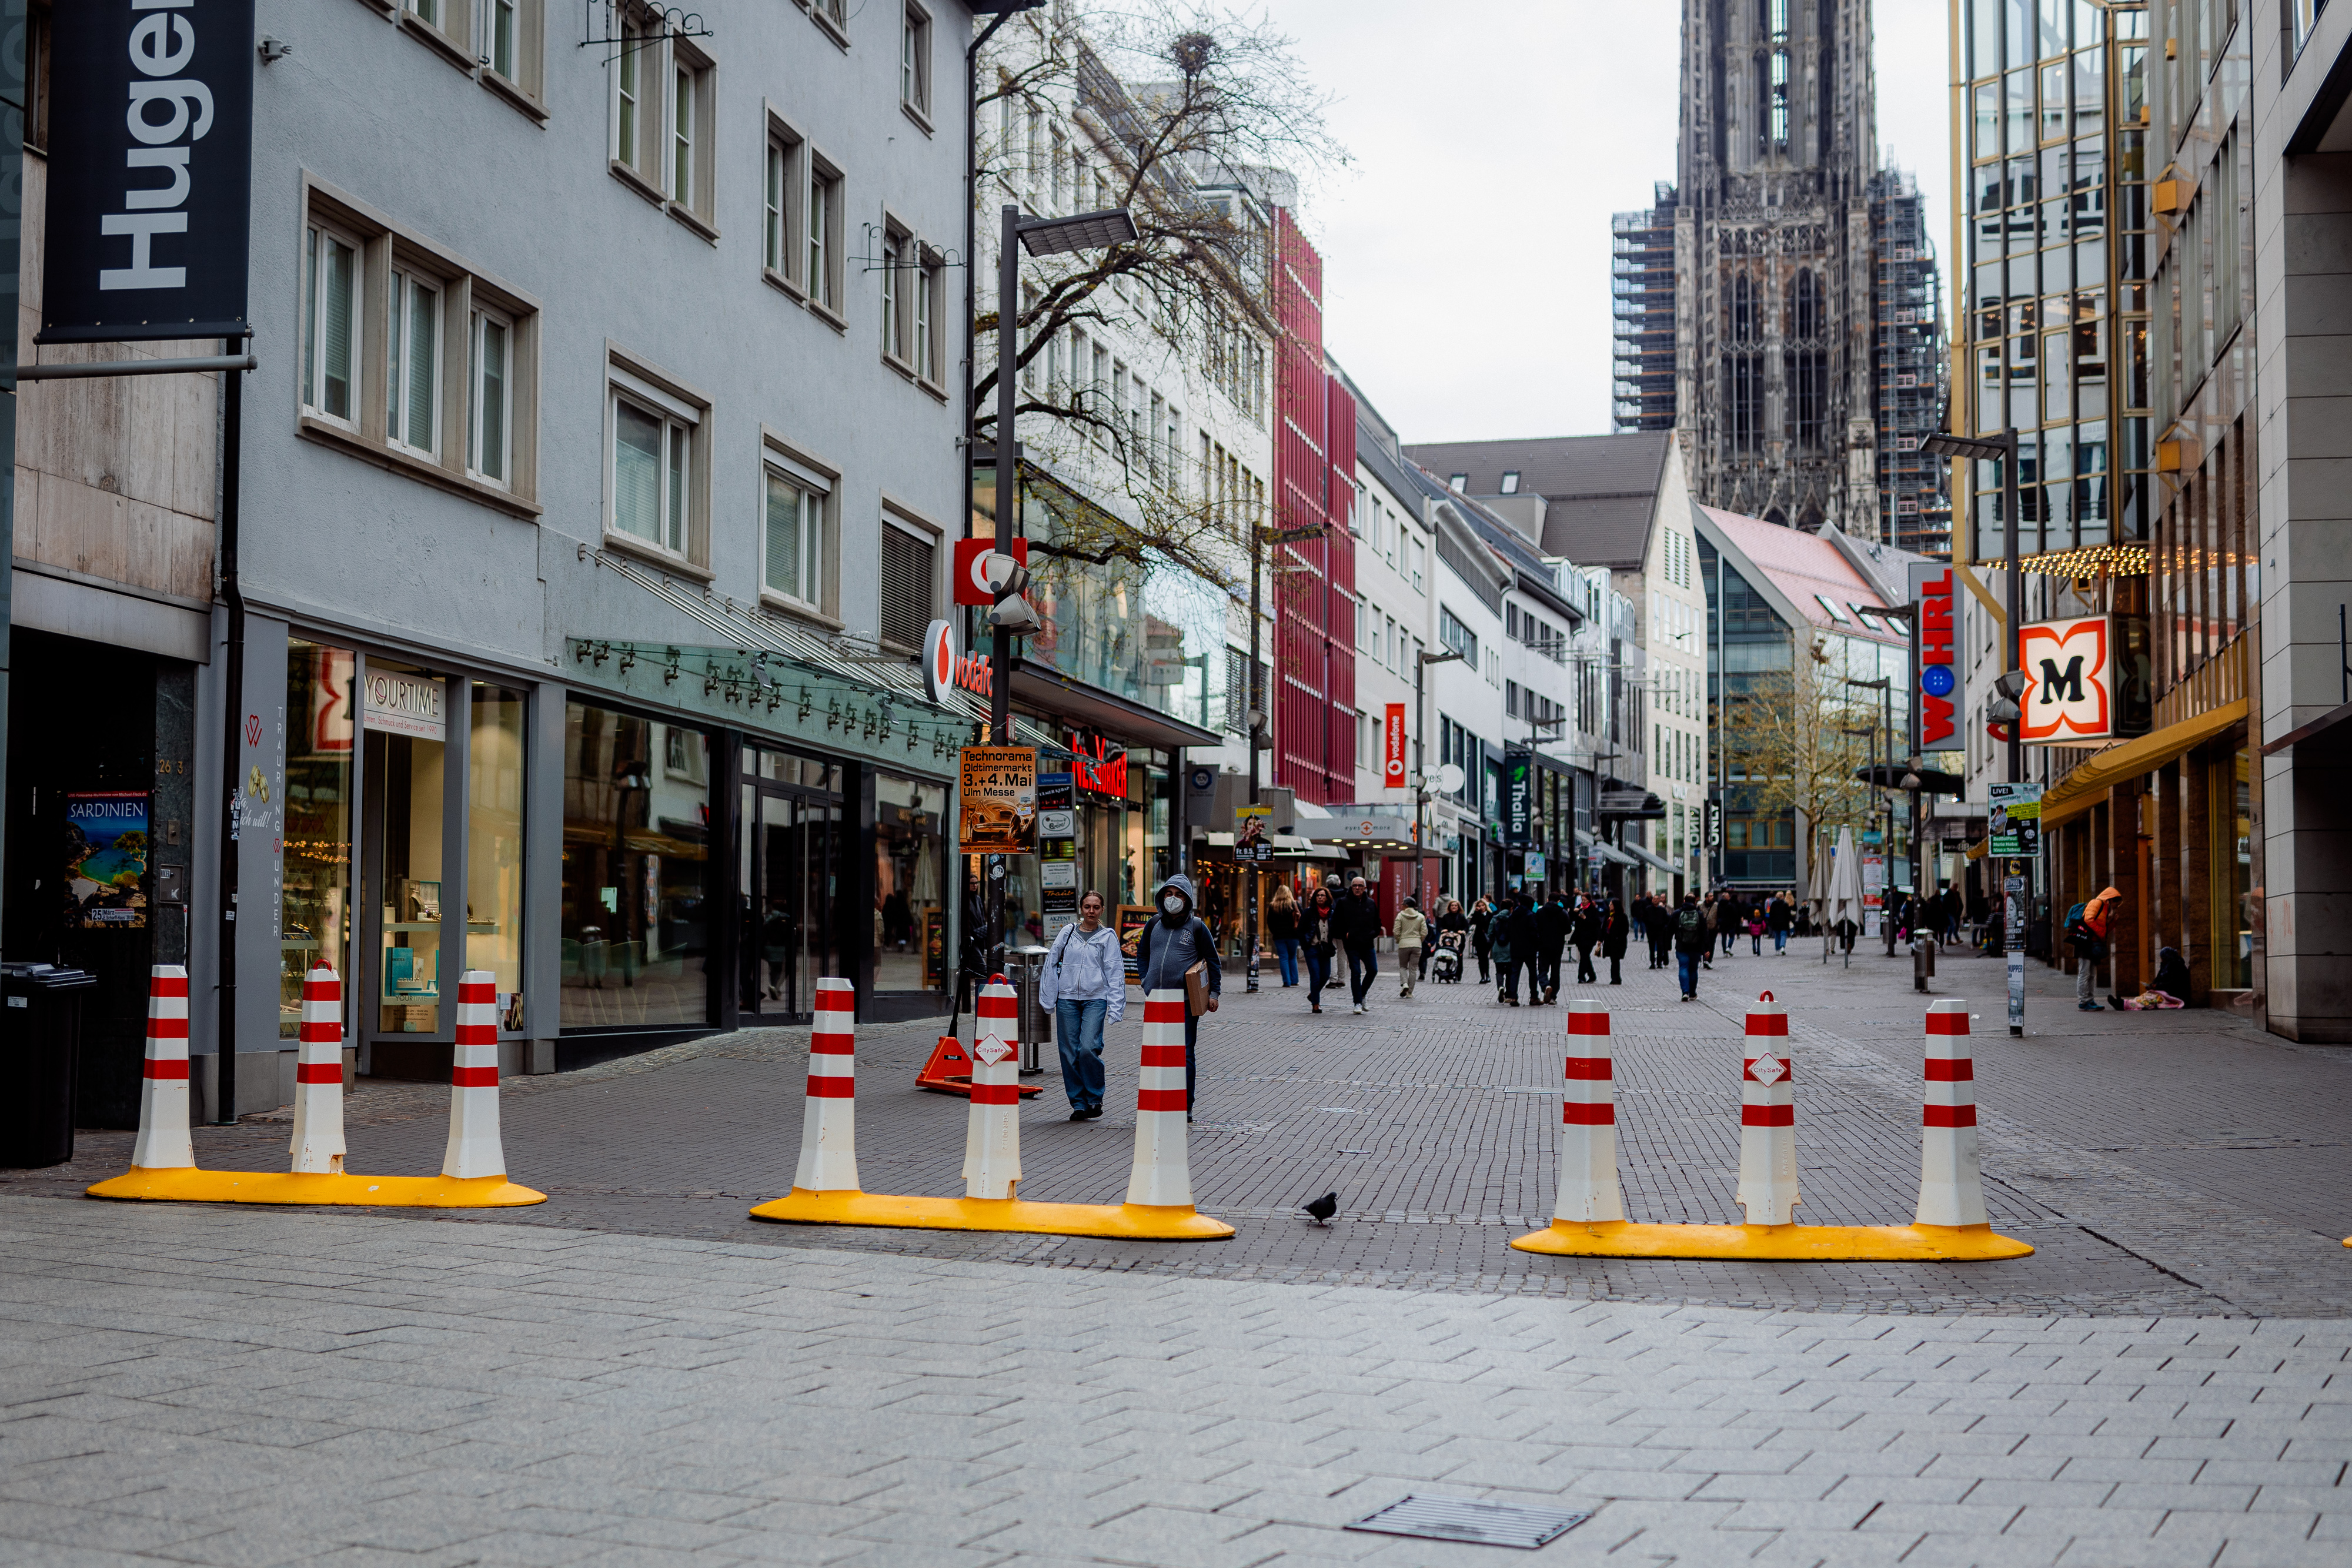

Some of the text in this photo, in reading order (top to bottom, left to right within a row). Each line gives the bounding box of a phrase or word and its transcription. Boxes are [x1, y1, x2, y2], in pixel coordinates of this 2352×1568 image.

[100, 0, 214, 290] Huge
[2039, 656, 2085, 704] M
[365, 674, 438, 717] YOURTIME
[378, 716, 395, 727] Schmuck
[405, 721, 418, 731] Service
[427, 725, 437, 734] 1990
[1390, 716, 1399, 758] vodafone
[963, 750, 1032, 761] Technorama
[159, 759, 183, 774] 26 3
[964, 763, 1032, 772] Oldtimermarkt
[964, 787, 1015, 796] Ulm Messe
[71, 803, 143, 818] SARDINIEN
[1512, 781, 1526, 833] Thalia
[92, 910, 102, 920] 25
